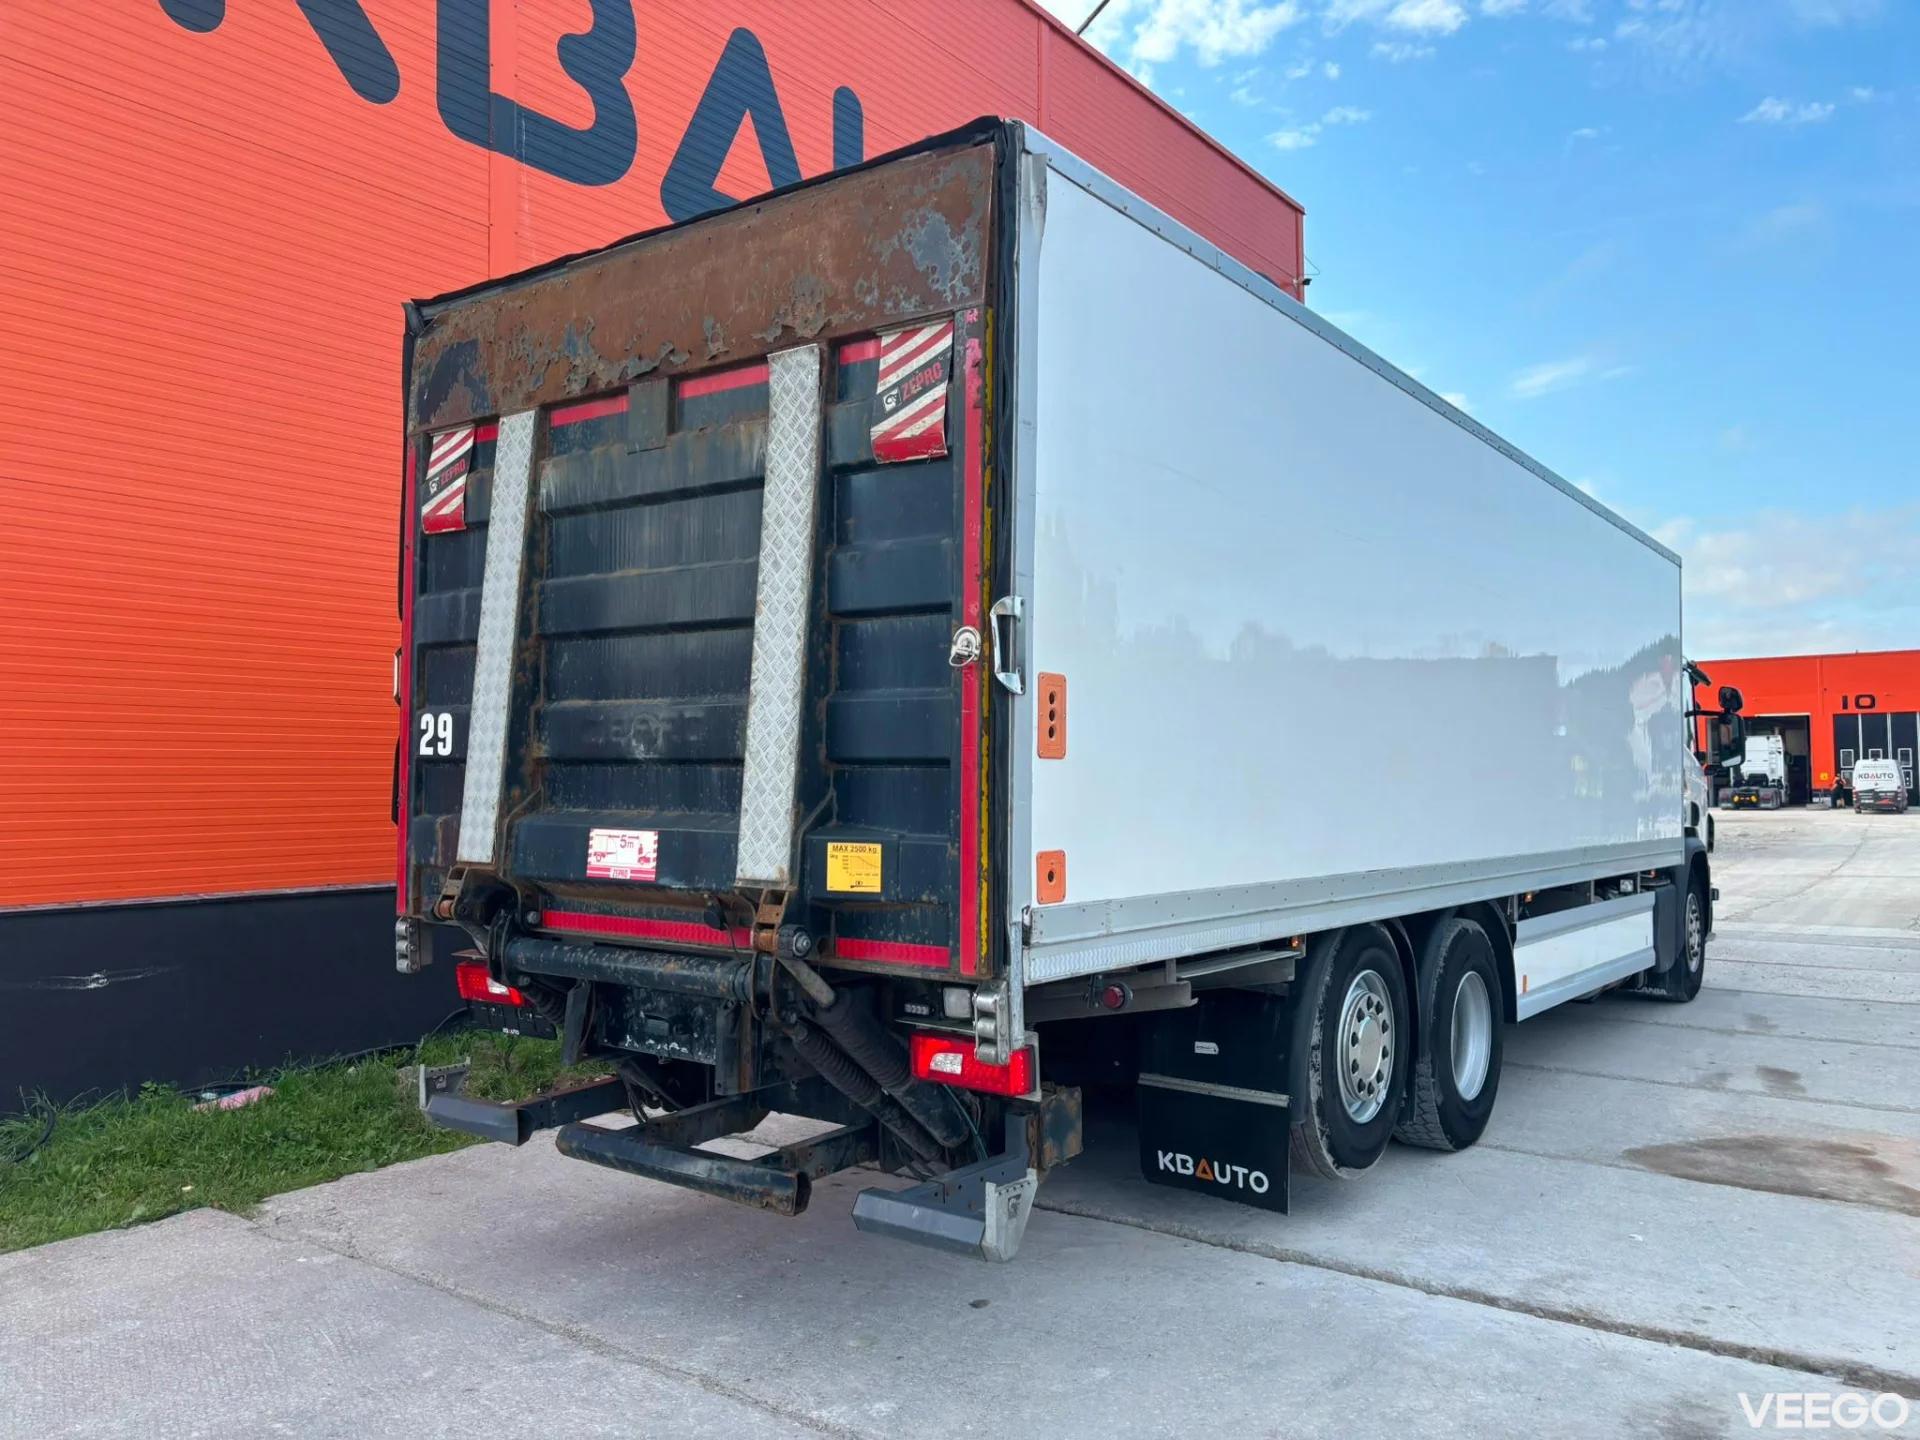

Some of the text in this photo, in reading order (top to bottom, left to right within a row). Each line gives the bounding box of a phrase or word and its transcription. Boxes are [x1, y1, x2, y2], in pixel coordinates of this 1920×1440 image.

[158, 0, 864, 223] BA
[440, 458, 466, 485] ZEPRO
[1841, 694, 1876, 710] 10
[419, 712, 453, 756] 29
[832, 844, 878, 855] MAX 2500 kg
[1157, 1149, 1270, 1194] KBAUTO
